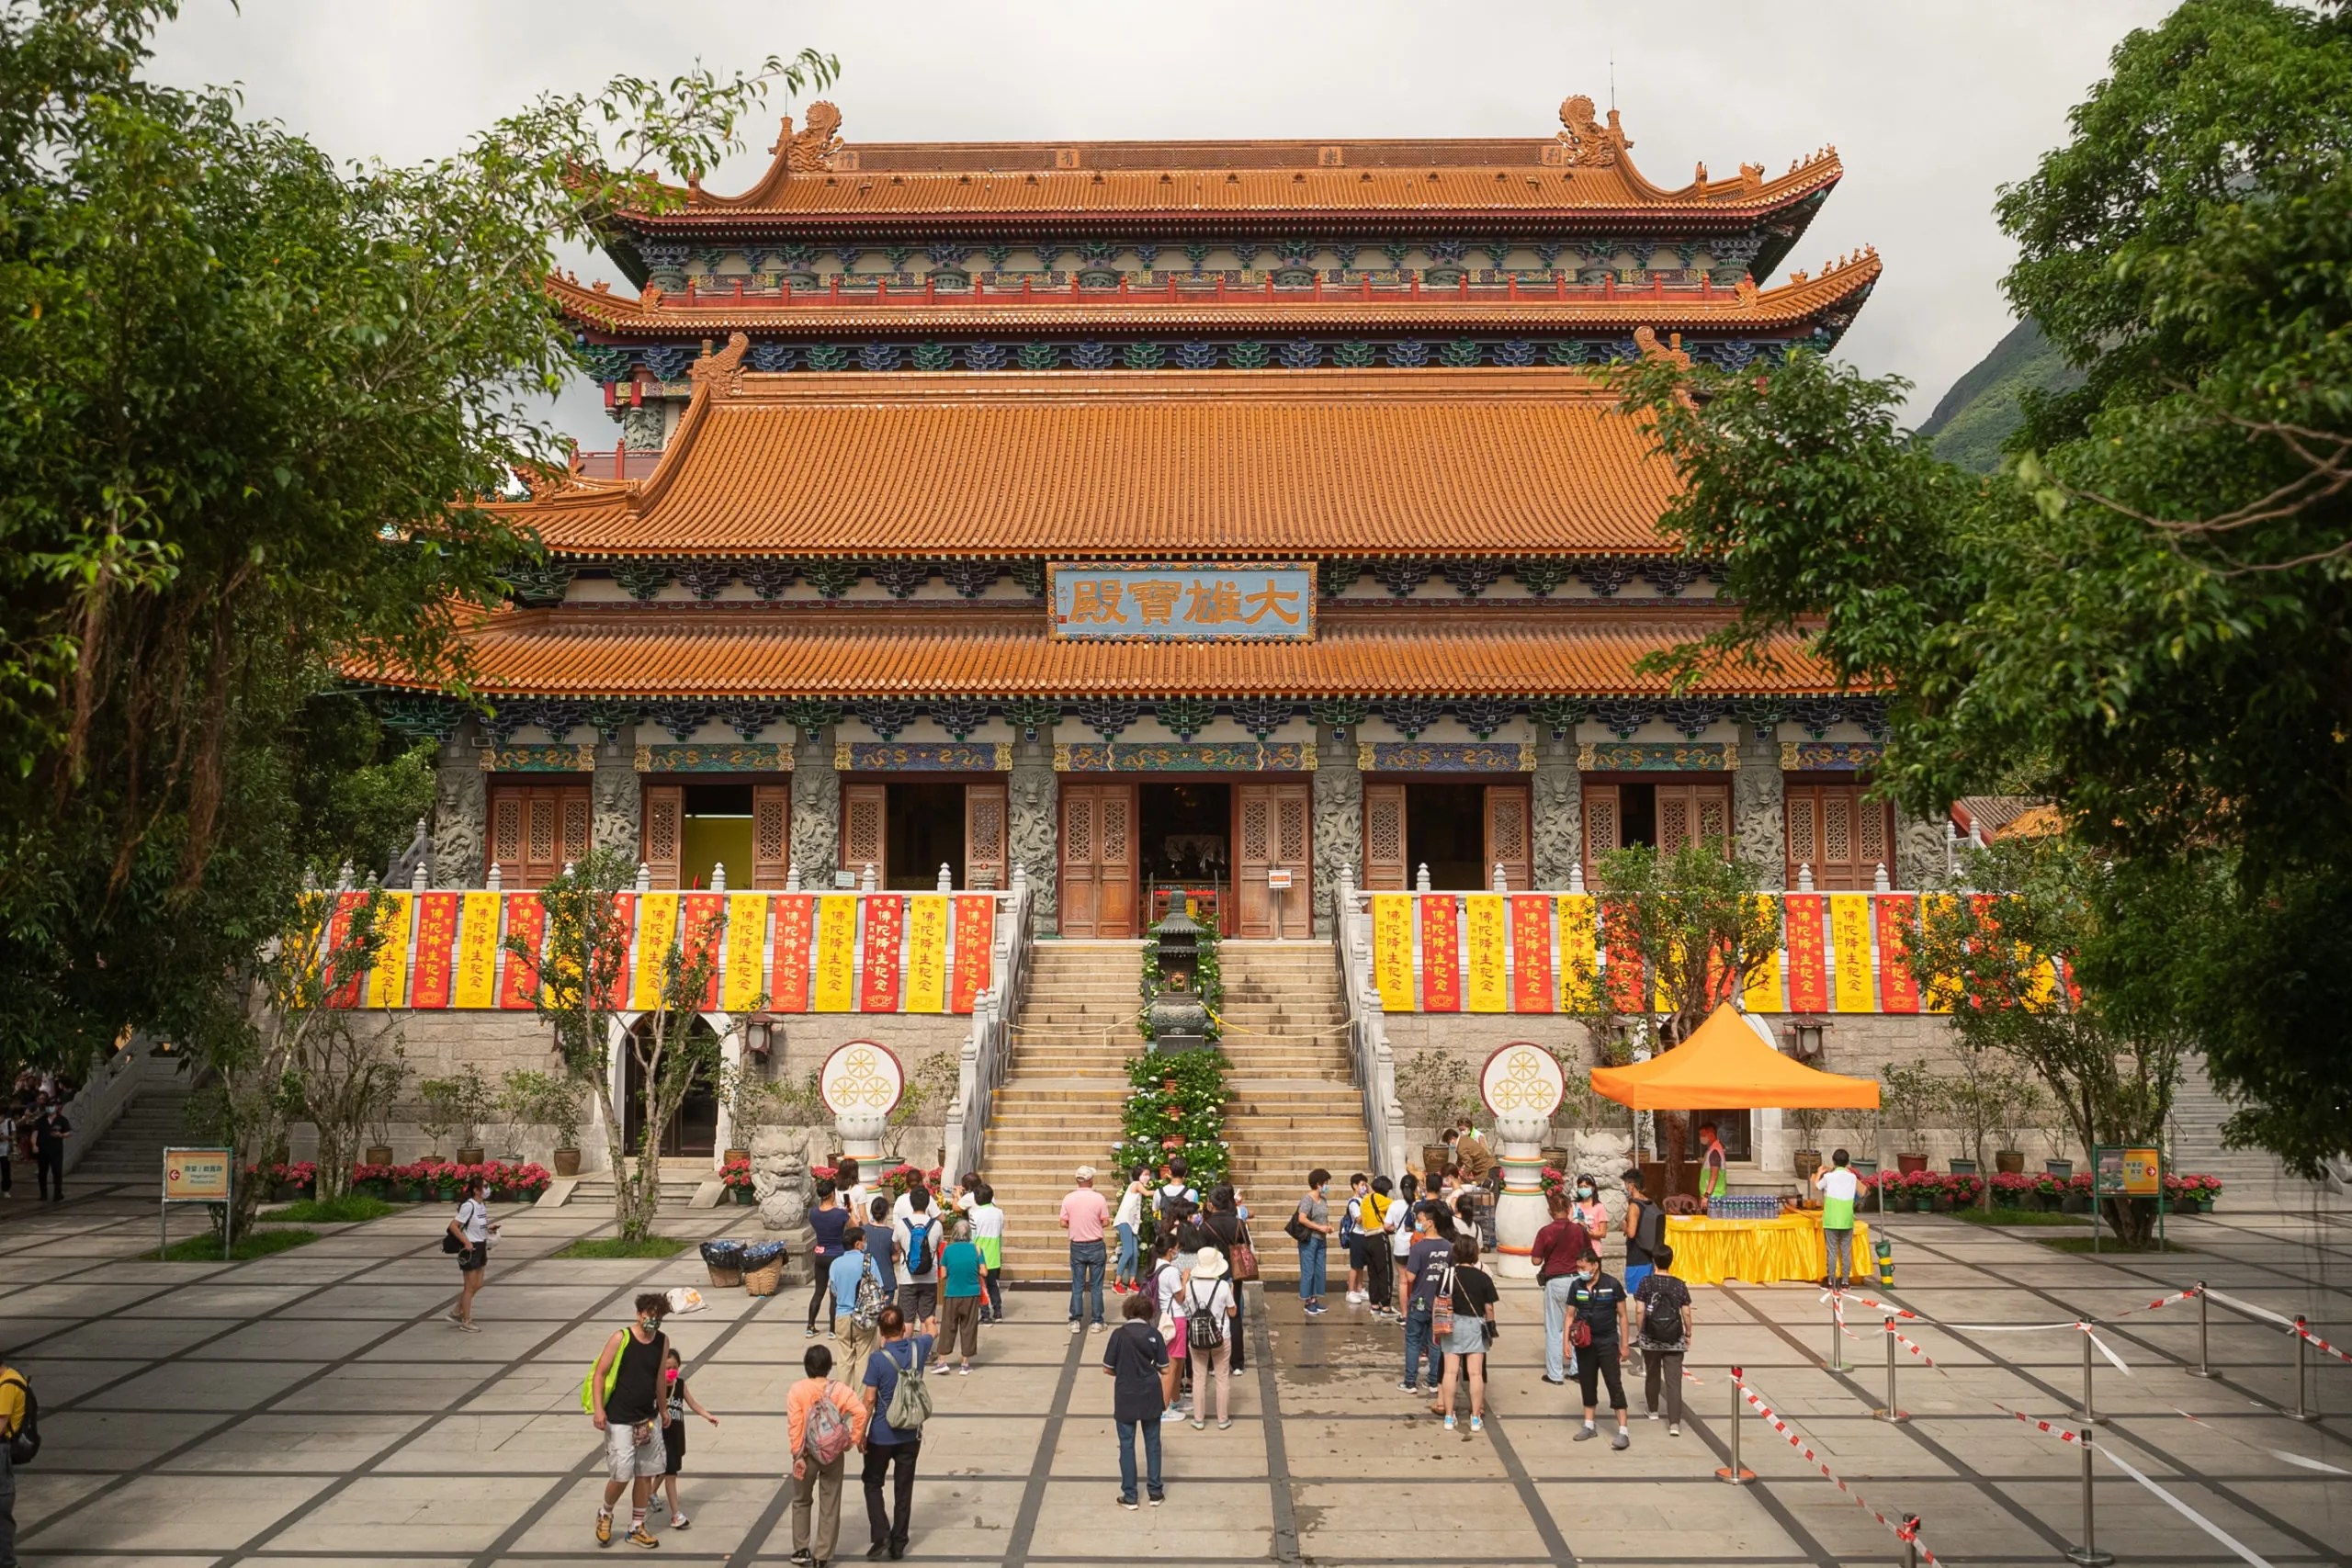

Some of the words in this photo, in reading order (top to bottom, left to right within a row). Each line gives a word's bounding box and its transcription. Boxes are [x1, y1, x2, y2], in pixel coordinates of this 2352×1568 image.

[1069, 579, 1300, 626] 大雄寶殿
[424, 908, 444, 988] 佛陀降生紀念
[469, 908, 489, 987] 佛陀降生紀念
[647, 909, 665, 989] 佛陀降生紀念
[737, 910, 755, 990] 佛陀降生紀念
[783, 911, 799, 992] 佛陀降生紀念
[828, 911, 845, 991] 佛陀降生紀念
[874, 910, 891, 992] 佛陀降生紀念
[918, 911, 935, 991] 佛陀降生紀念
[964, 910, 980, 992] 佛陀降生紀念
[1386, 910, 1401, 990] 佛陀降生紀念
[1431, 909, 1448, 991] 佛陀降生紀念
[1478, 910, 1494, 991] 佛陀降生紀念
[1524, 912, 1542, 994] 佛陀降生紀念
[1796, 911, 1815, 992] 佛陀降生紀念
[1844, 910, 1861, 991] 佛陀降生紀念
